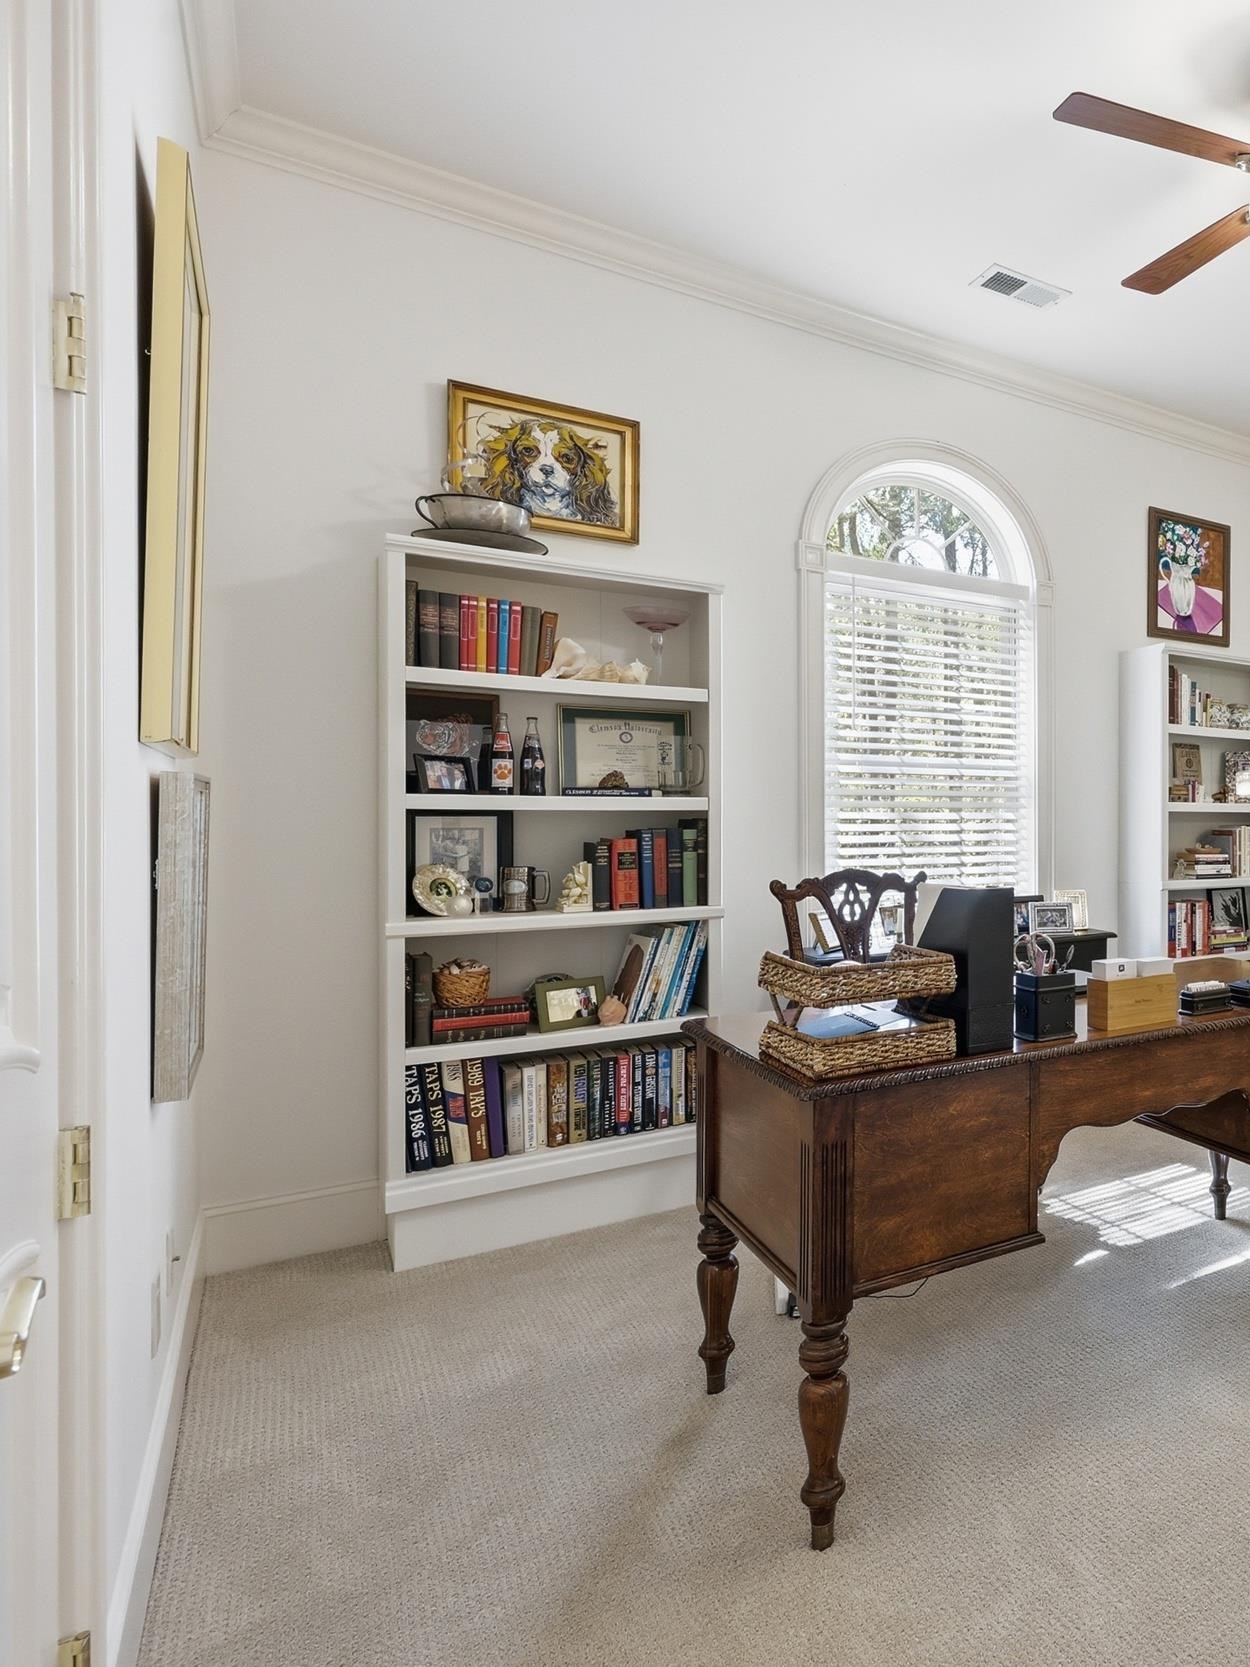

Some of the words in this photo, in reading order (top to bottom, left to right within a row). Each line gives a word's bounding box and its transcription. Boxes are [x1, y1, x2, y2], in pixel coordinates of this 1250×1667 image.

[405, 1065, 421, 1105] TAPS
[425, 1062, 442, 1101] TAPS
[466, 1059, 482, 1086] 1989
[429, 1104, 446, 1132] 1987
[469, 1089, 486, 1118] TAPS
[408, 1108, 426, 1138] 1986
